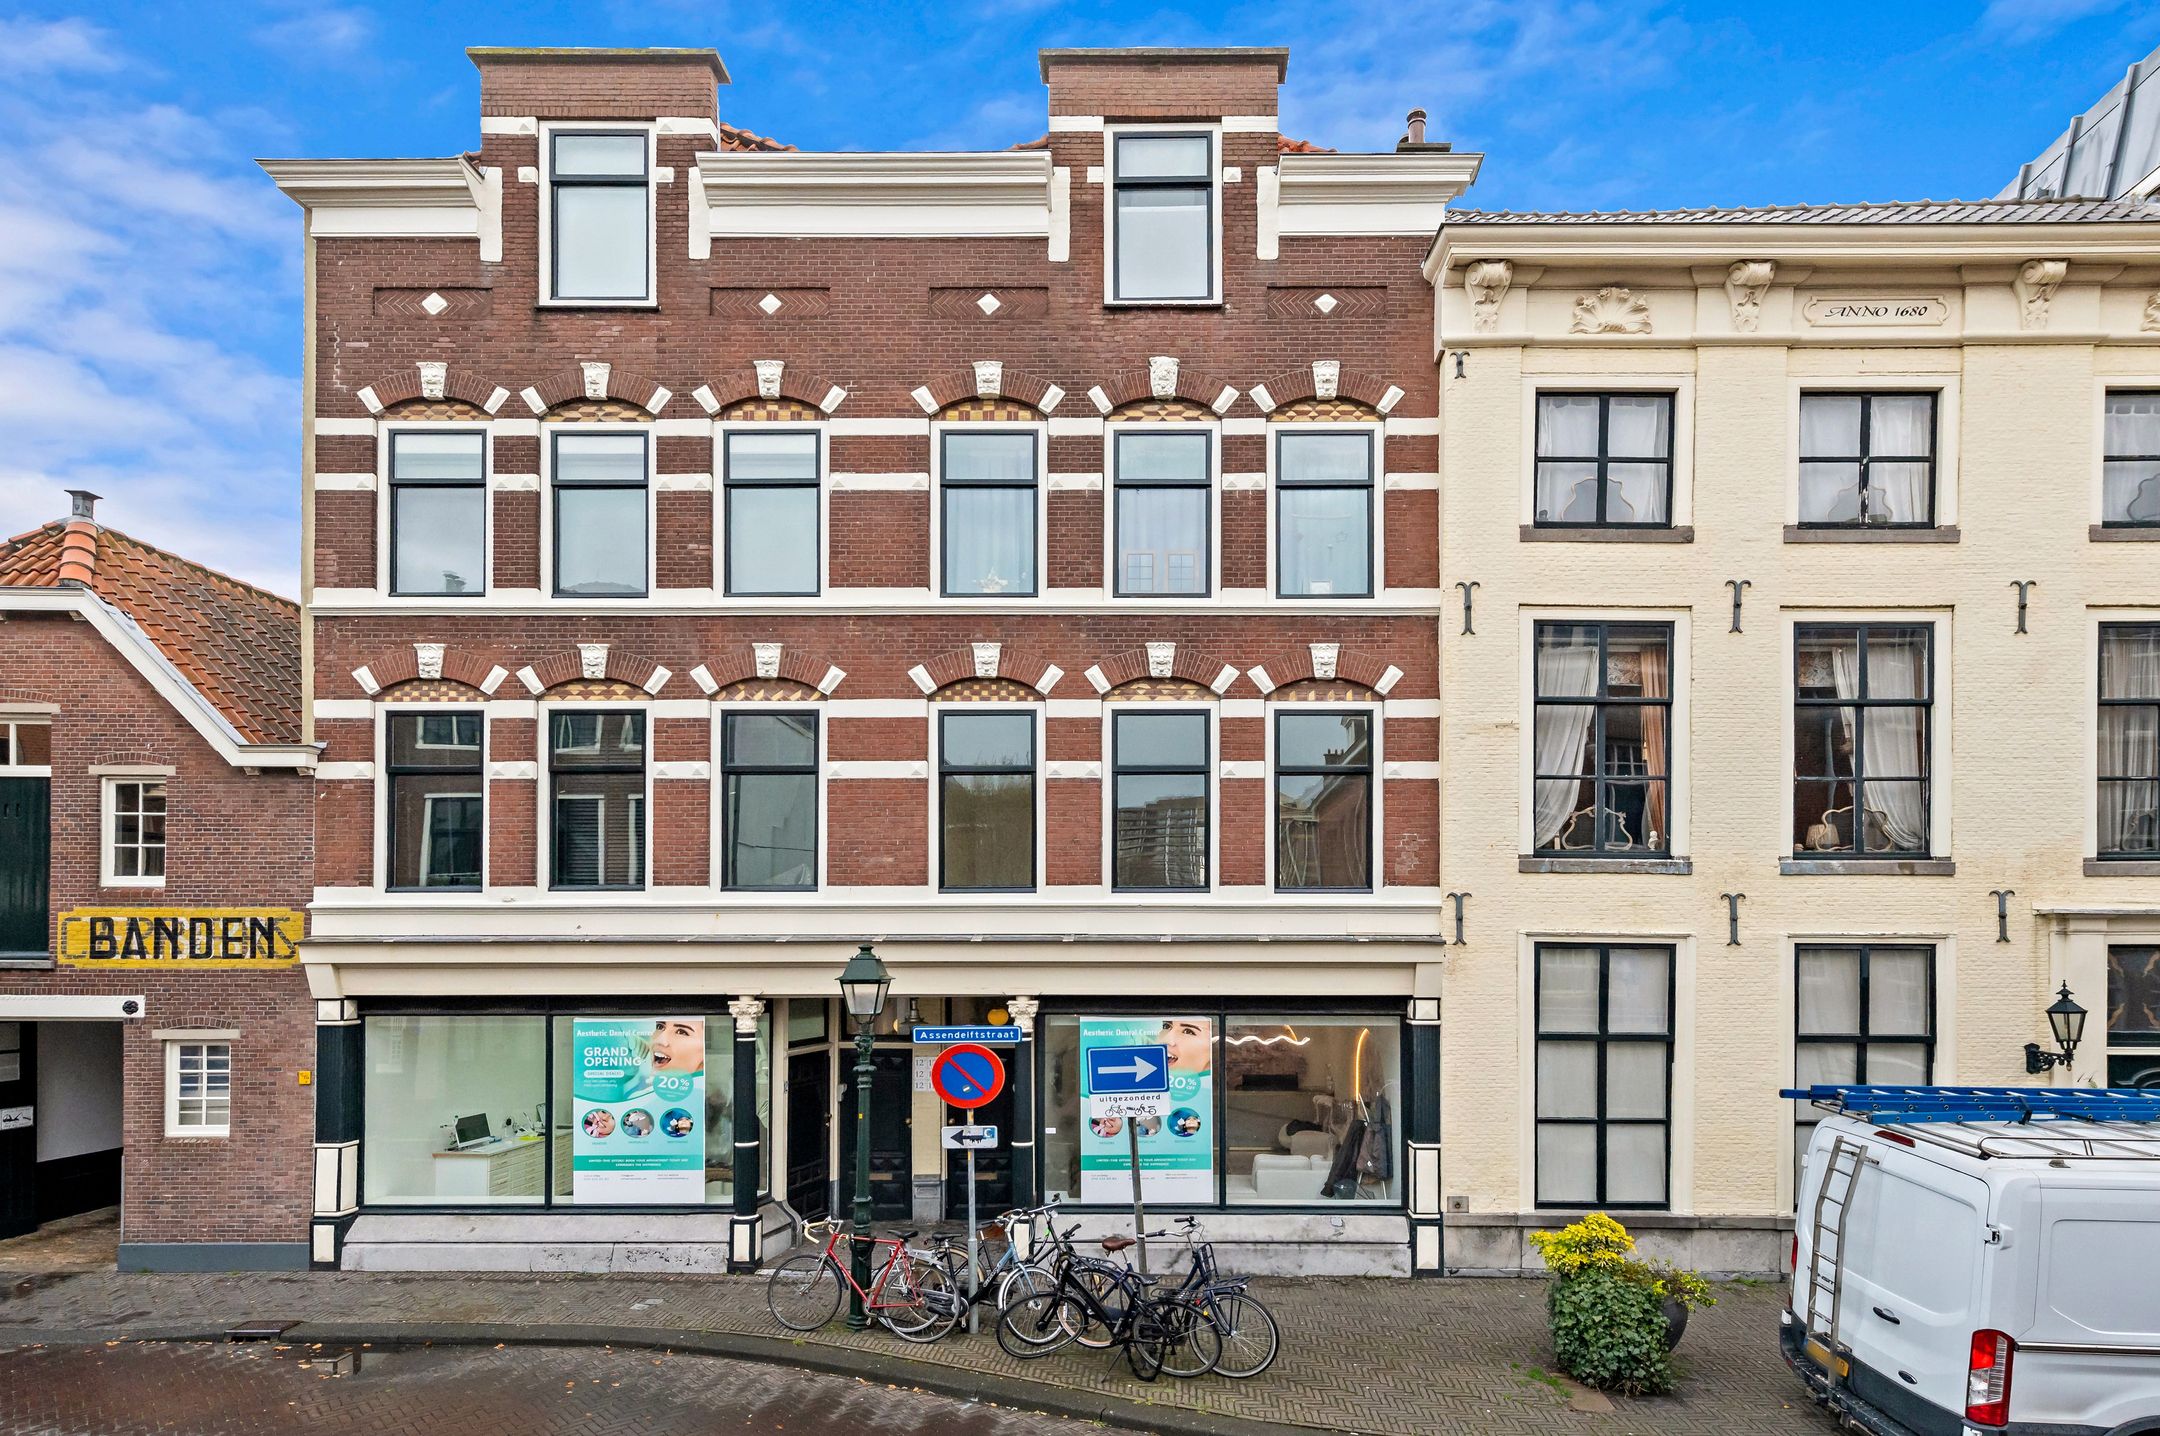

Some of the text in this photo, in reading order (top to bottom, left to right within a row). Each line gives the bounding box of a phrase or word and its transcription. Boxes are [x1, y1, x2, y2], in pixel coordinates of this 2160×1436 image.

[1825, 305, 1928, 317] ANNO 1680
[89, 916, 275, 960] BANDEN
[577, 1029, 607, 1037] Aesthetic
[920, 1031, 1014, 1039] Assendelftstraat
[1083, 1029, 1113, 1037] Aesthetic
[584, 1046, 629, 1057] GRAND
[584, 1056, 642, 1067] OPENING
[1099, 1094, 1161, 1103] uitgezonderd
